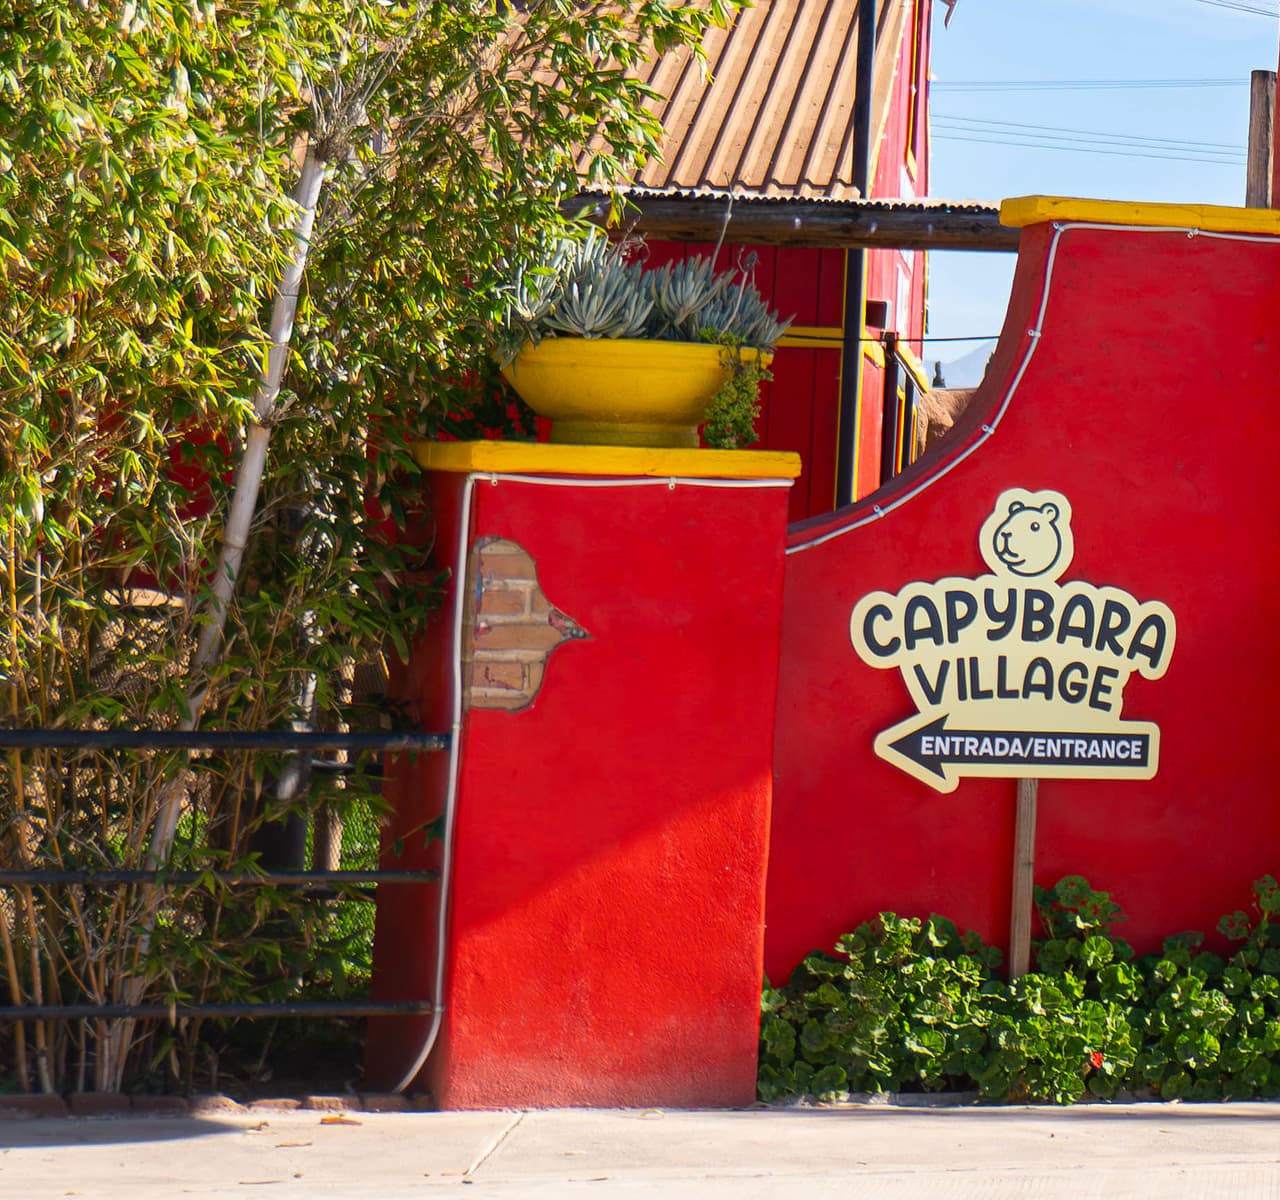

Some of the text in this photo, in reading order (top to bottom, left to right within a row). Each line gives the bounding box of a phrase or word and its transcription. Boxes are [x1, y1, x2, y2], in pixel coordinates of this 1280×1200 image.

[863, 588, 1166, 669] CAPYBARA
[913, 655, 1119, 712] VILLAGE
[920, 735, 1142, 760] ENTRADA/ENTRANCE
